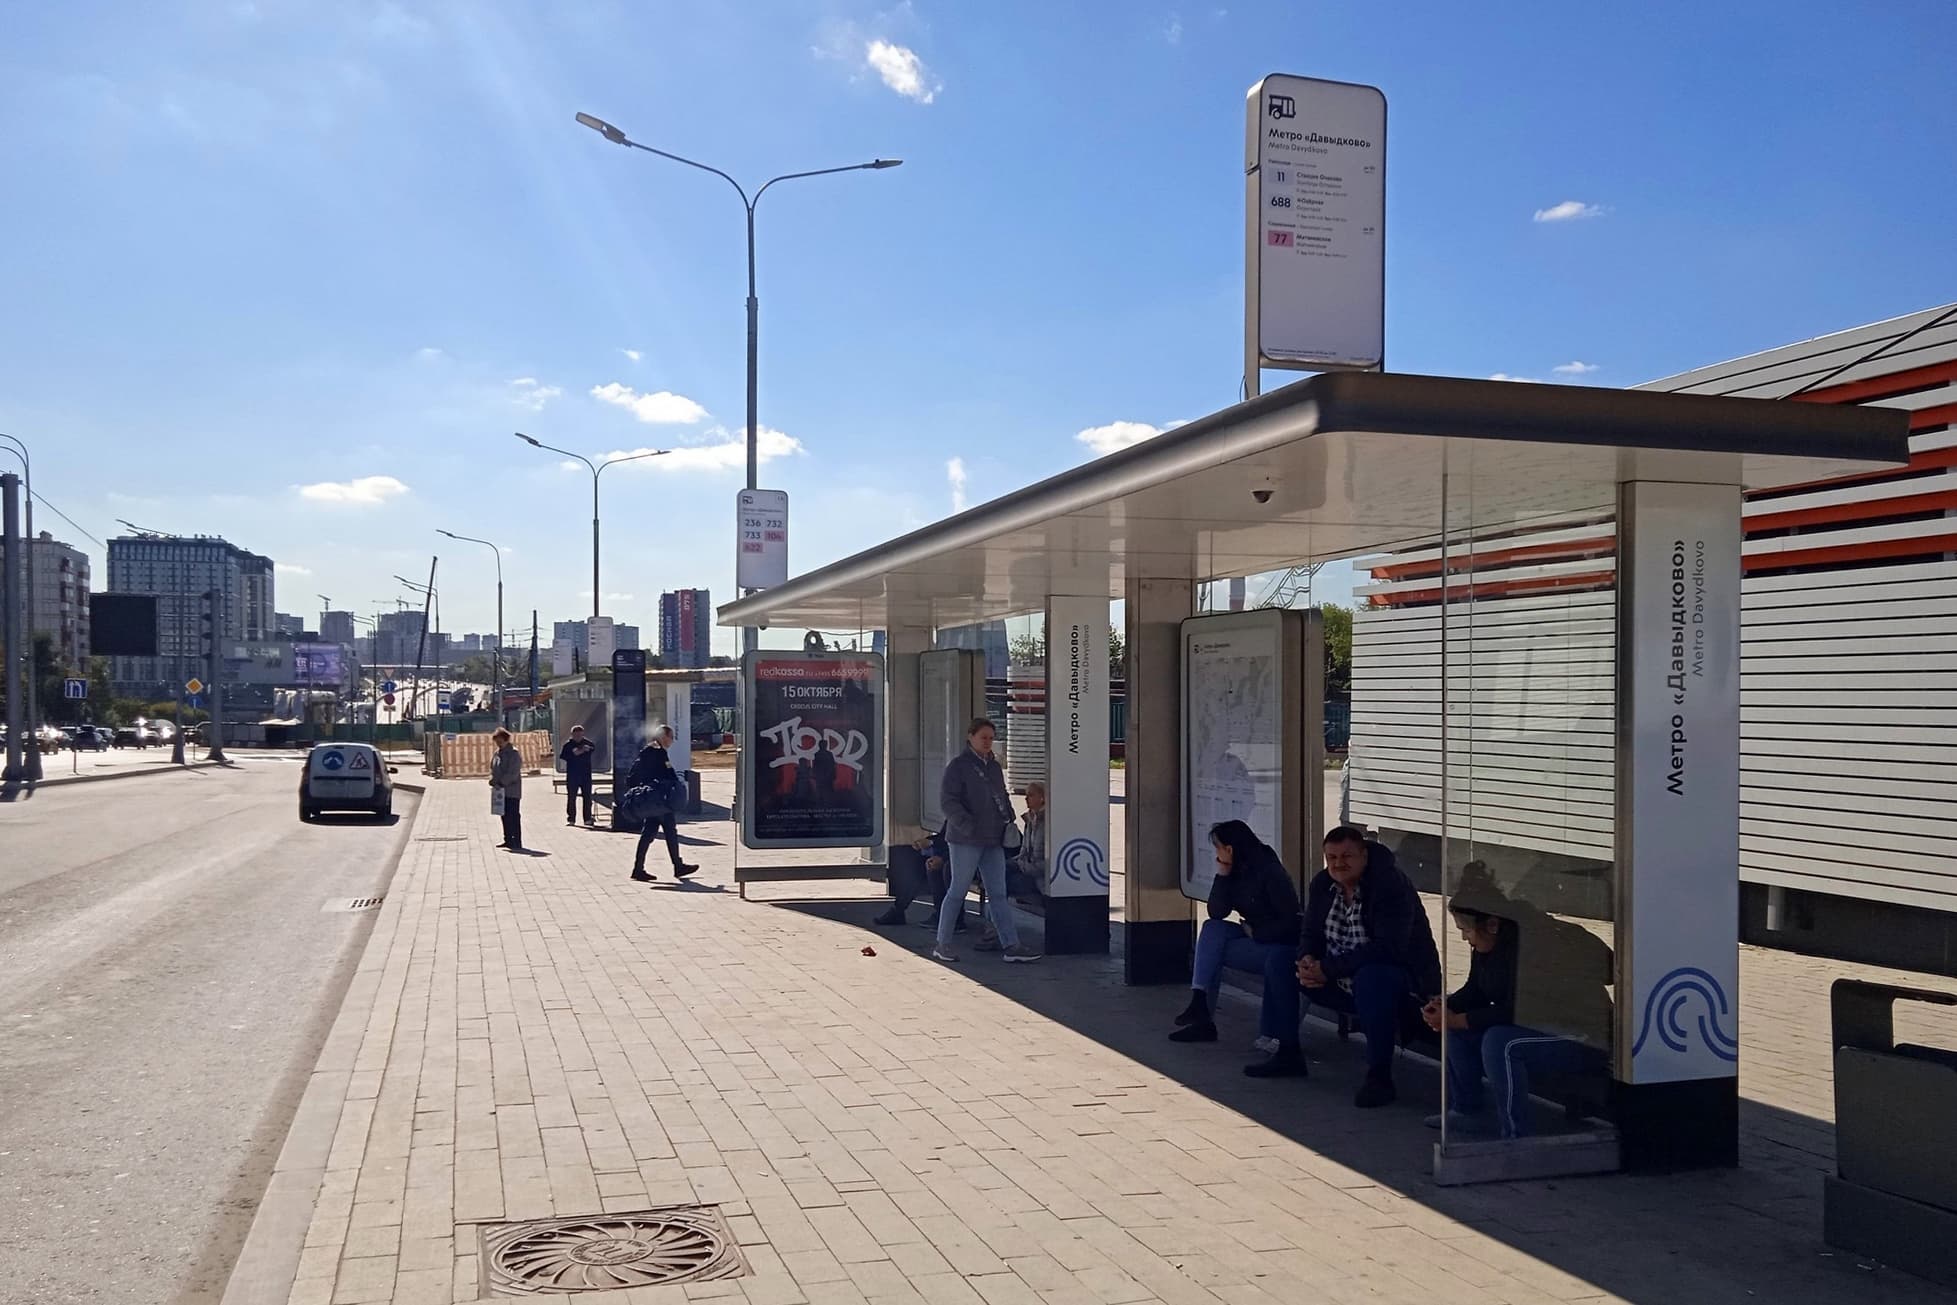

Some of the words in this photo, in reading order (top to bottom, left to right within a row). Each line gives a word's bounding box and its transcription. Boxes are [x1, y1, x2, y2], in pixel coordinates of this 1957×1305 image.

[1268, 142, 1290, 151] Metro
[1291, 144, 1328, 154] Davydkovo
[1269, 128, 1302, 141] Метро
[1305, 133, 1371, 148] «Давыдково»
[1277, 171, 1285, 182] 11
[1271, 197, 1291, 208] 688
[1274, 233, 1288, 245] 77
[745, 519, 761, 527] 236
[767, 519, 783, 528] 732
[745, 531, 761, 539] 733
[1692, 540, 1707, 625] Davydkovo
[1667, 540, 1687, 705] «Давыдково»
[1083, 624, 1091, 666] Davydkovo
[1692, 629, 1704, 677] Metro
[1069, 625, 1081, 709] «Давыдково»
[781, 685, 796, 698] 15
[797, 686, 842, 698] ОКТЯБРЯ
[1069, 712, 1081, 755] Метро
[1667, 714, 1687, 796] Метро
